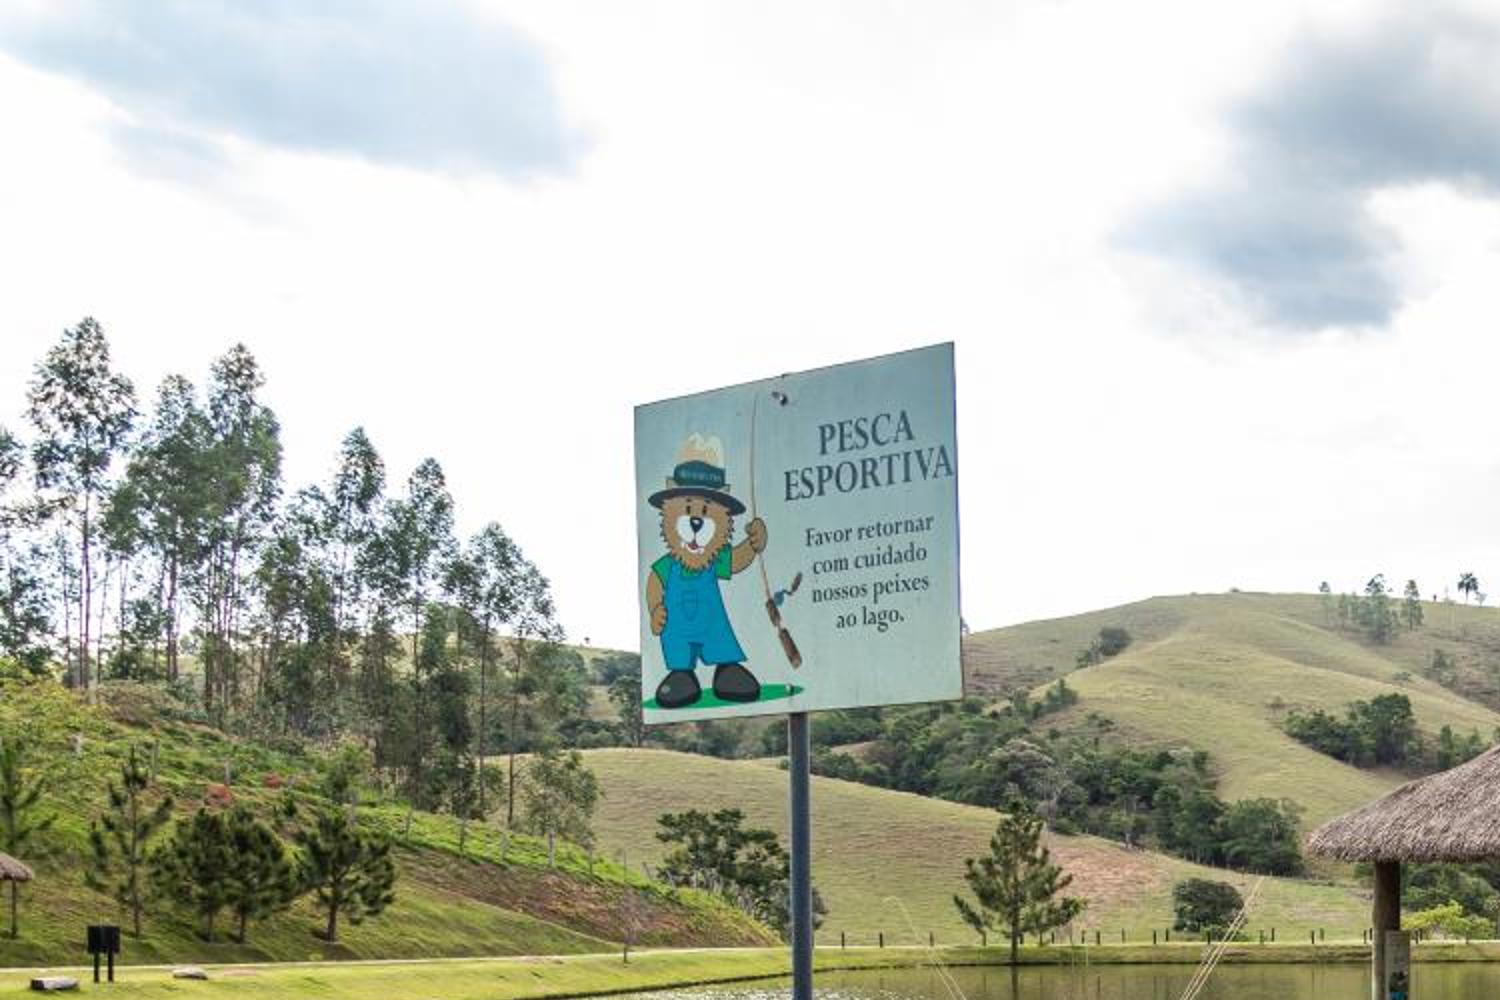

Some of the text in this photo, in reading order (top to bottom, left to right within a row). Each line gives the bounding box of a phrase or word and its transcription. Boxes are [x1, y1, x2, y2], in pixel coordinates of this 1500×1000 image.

[819, 410, 914, 455] PESCA
[784, 445, 954, 501] ESPORTIVA
[806, 516, 934, 547] Favor retornar
[813, 541, 928, 575] com cuidado
[812, 572, 929, 604] nossos peixes
[836, 605, 905, 633] ao lago.
